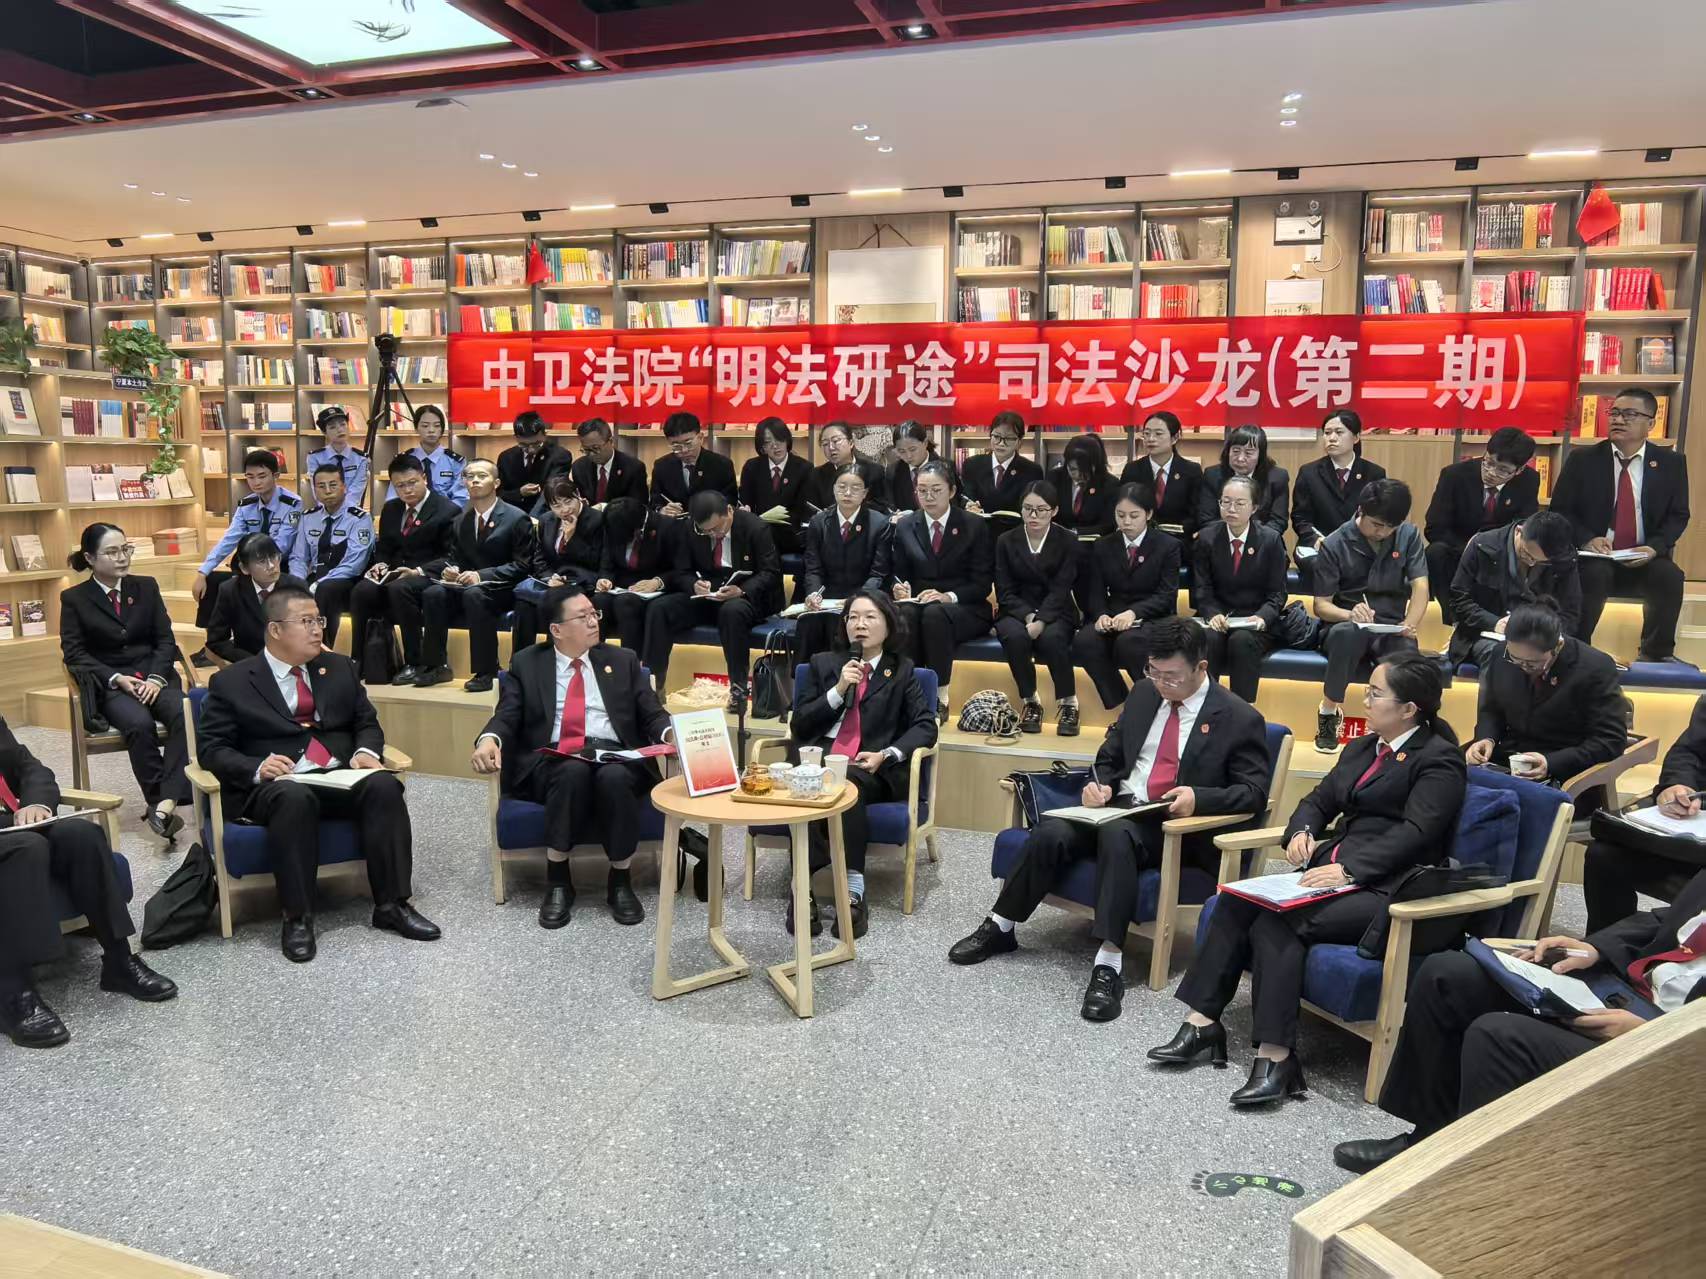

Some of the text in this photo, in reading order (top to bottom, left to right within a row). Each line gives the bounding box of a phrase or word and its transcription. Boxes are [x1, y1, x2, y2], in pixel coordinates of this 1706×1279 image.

[483, 335, 1527, 411] 中卫法院“明法研途”司法沙龙(第二期)
